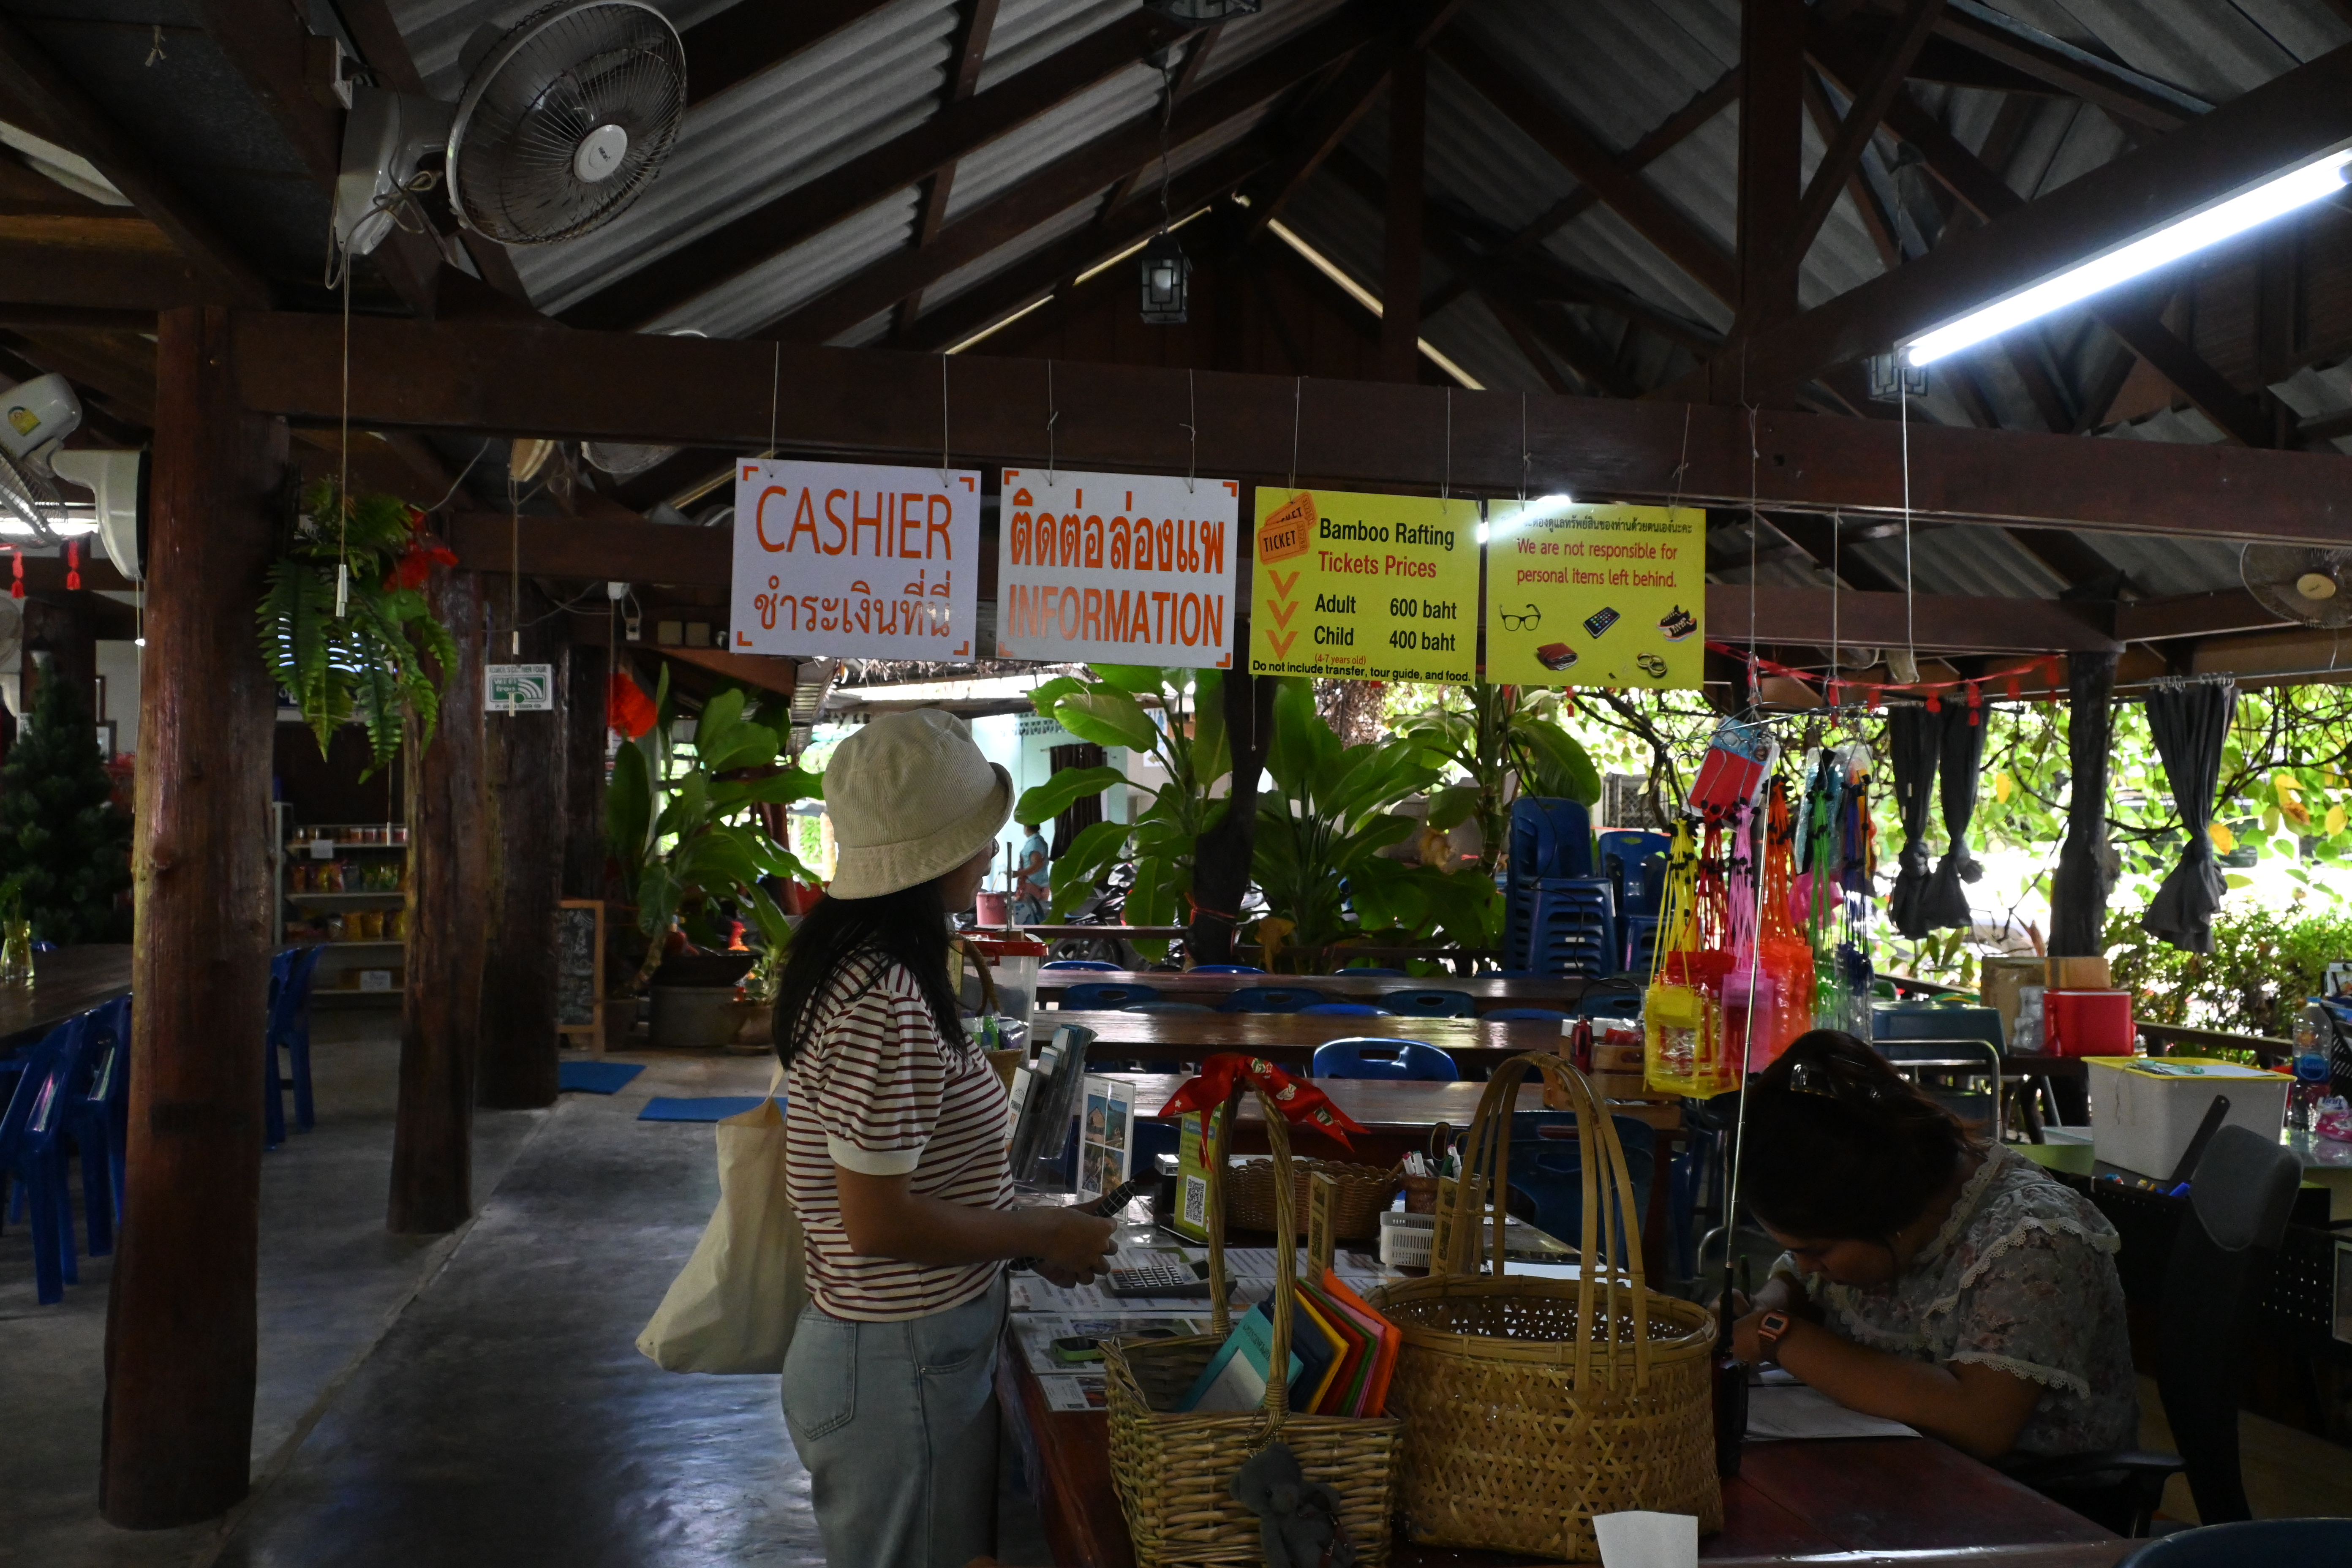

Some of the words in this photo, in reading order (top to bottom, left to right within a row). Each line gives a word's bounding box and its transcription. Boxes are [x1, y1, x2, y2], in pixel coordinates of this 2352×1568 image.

[756, 485, 952, 560] CASHIER
[1011, 487, 1225, 574] ติดต่อล่องแพ
[1320, 518, 1389, 542] Bamboo
[1396, 523, 1454, 551] Rafting
[1263, 530, 1295, 552] TICKET
[1518, 538, 1536, 554] We
[1541, 542, 1560, 555] are
[1564, 541, 1584, 556] not
[1589, 542, 1657, 561] responsible
[1661, 543, 1678, 560] for
[1318, 551, 1379, 574] Tickets
[1385, 555, 1437, 578] Prices
[1517, 566, 1569, 586] personal
[1573, 567, 1604, 585] items
[1609, 568, 1629, 586] left
[1633, 569, 1677, 588] behind.
[754, 569, 950, 638] ชำระเงินที่นี่
[1008, 584, 1223, 647] INFORMATION
[1315, 593, 1356, 614] Adult
[1390, 598, 1417, 617] 600
[1423, 599, 1457, 620] baht
[1314, 625, 1354, 646] Child
[1389, 630, 1416, 649] 400
[1421, 632, 1456, 651] baht
[1253, 660, 1267, 671] Do
[1269, 662, 1285, 672] not
[1288, 662, 1323, 674] include
[1326, 664, 1368, 678] transfer,
[1370, 667, 1391, 678] tour
[1392, 668, 1423, 681] guide,
[1425, 670, 1443, 681] and
[1446, 670, 1471, 681] food.
[1315, 653, 1329, 664] (4-7
[1331, 656, 1350, 665] years
[1352, 656, 1367, 665] old)
